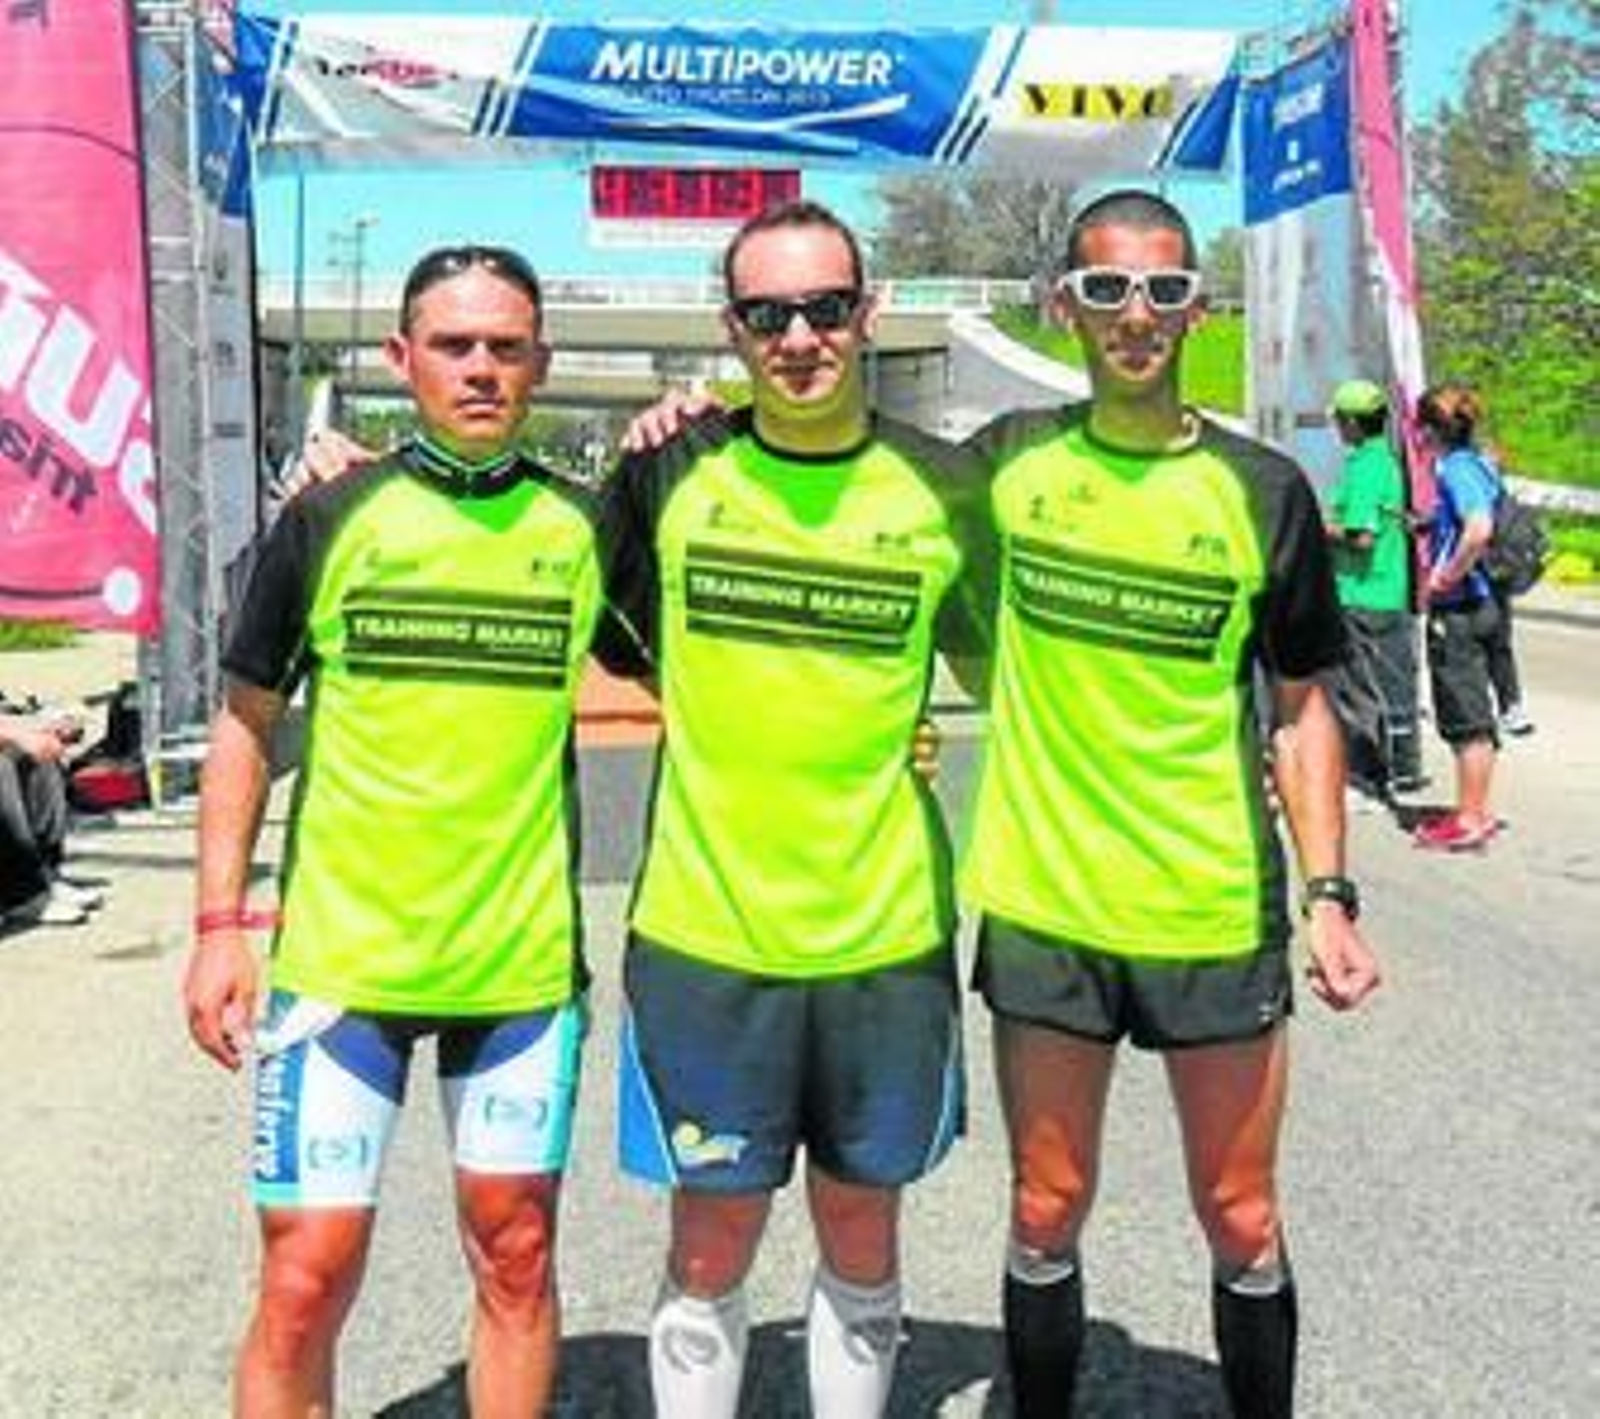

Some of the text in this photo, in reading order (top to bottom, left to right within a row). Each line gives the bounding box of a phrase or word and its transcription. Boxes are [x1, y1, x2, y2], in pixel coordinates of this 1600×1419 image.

[590, 40, 892, 86] MULTIPOWER
[689, 574, 913, 620] TRAINING MARKET
[1119, 592, 1225, 623] MARKET
[354, 617, 563, 648] TRAINING MARKET
